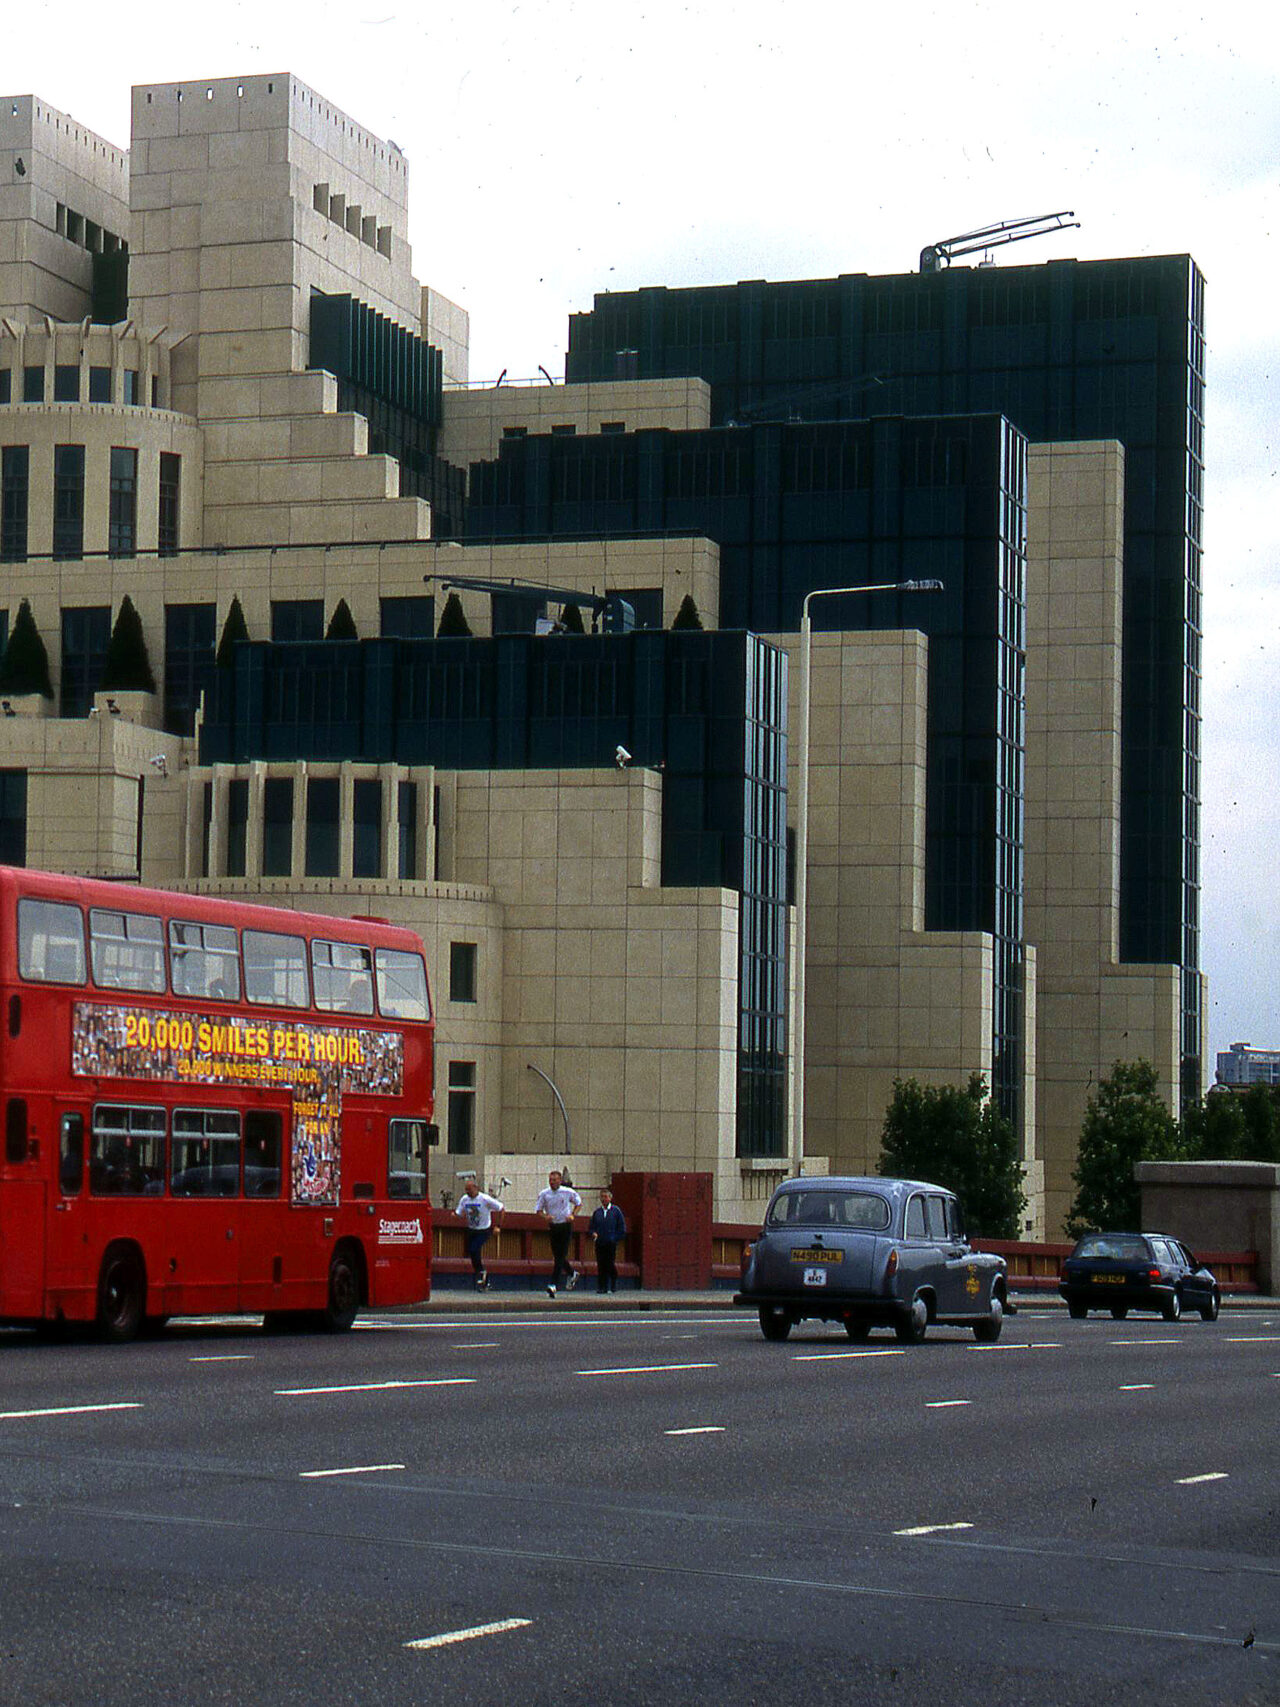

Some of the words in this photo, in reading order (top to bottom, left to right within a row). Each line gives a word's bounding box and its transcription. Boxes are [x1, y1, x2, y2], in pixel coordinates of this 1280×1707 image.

[125, 1015, 193, 1053] 20,000
[199, 1022, 270, 1057] SMILES
[273, 1029, 312, 1061] PER
[213, 1061, 259, 1079] WINNERS
[378, 1218, 417, 1237] Stagecoach
